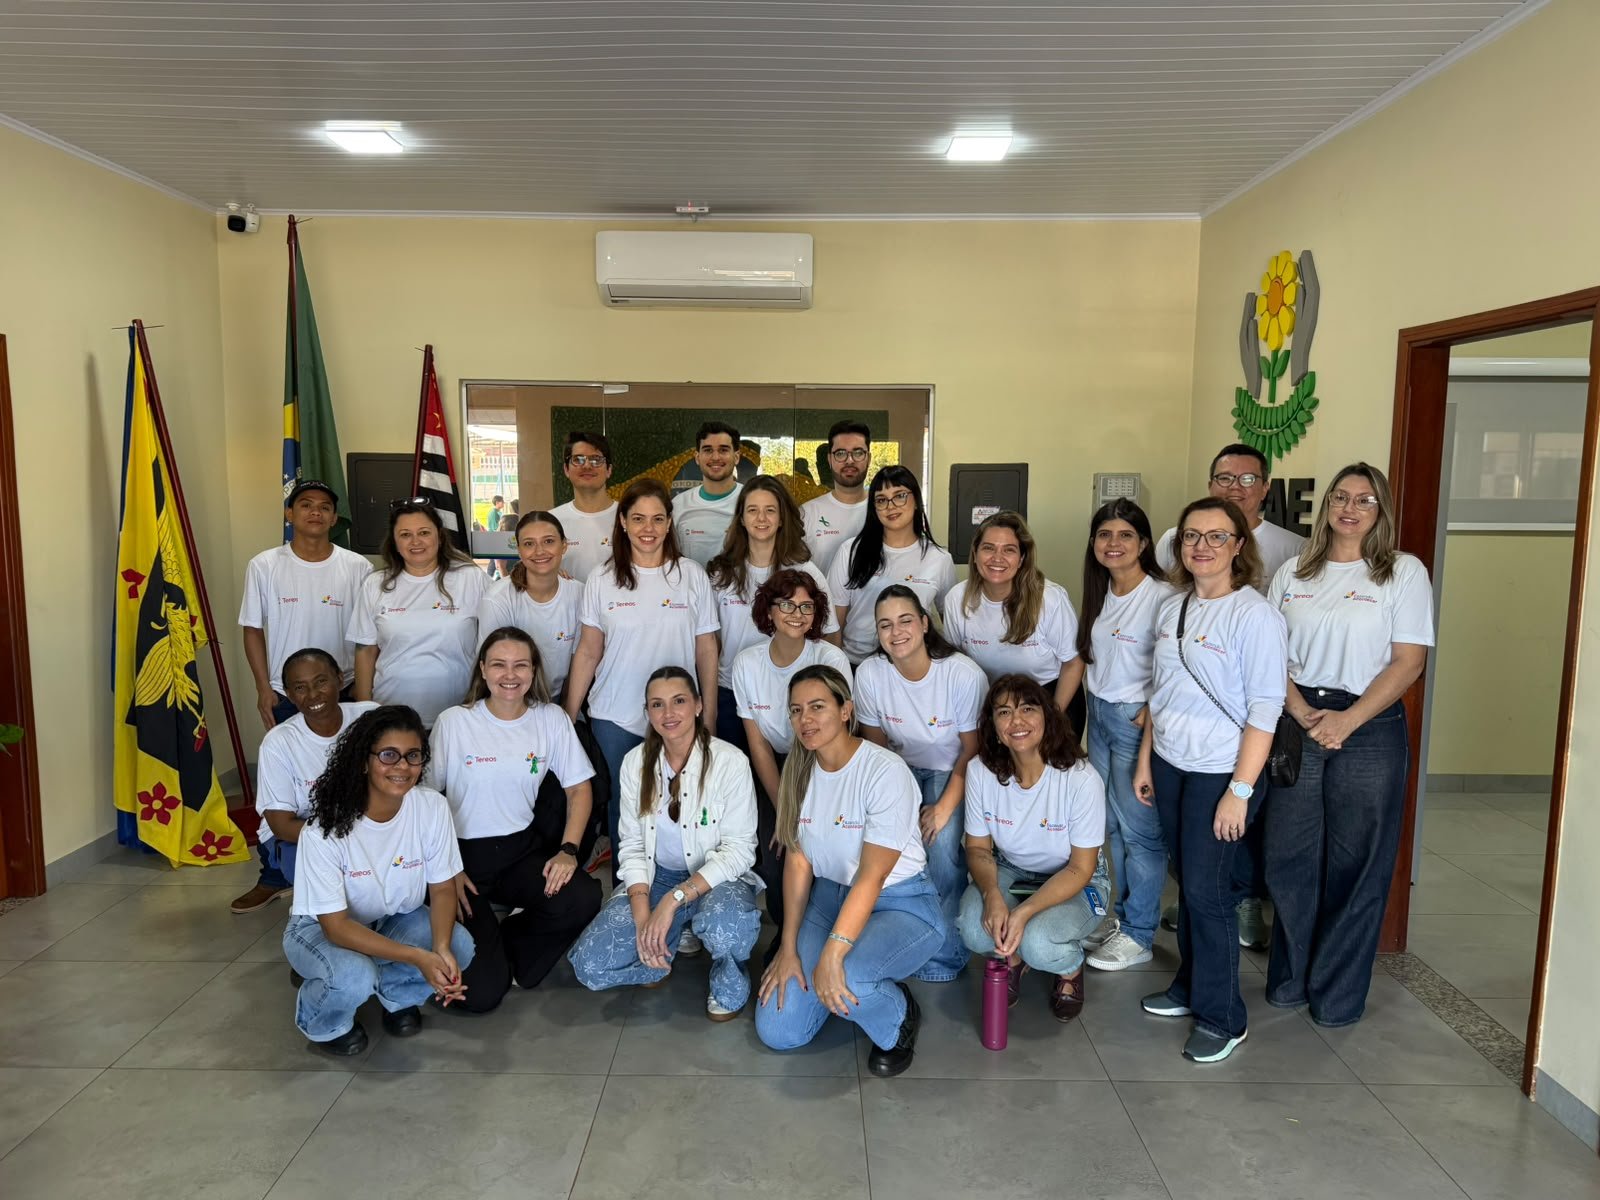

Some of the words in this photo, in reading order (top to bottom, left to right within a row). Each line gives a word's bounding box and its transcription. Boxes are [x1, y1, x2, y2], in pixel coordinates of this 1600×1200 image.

[1262, 478, 1315, 538] AE
[474, 755, 497, 763] Tereos
[349, 869, 372, 878] Tereos
